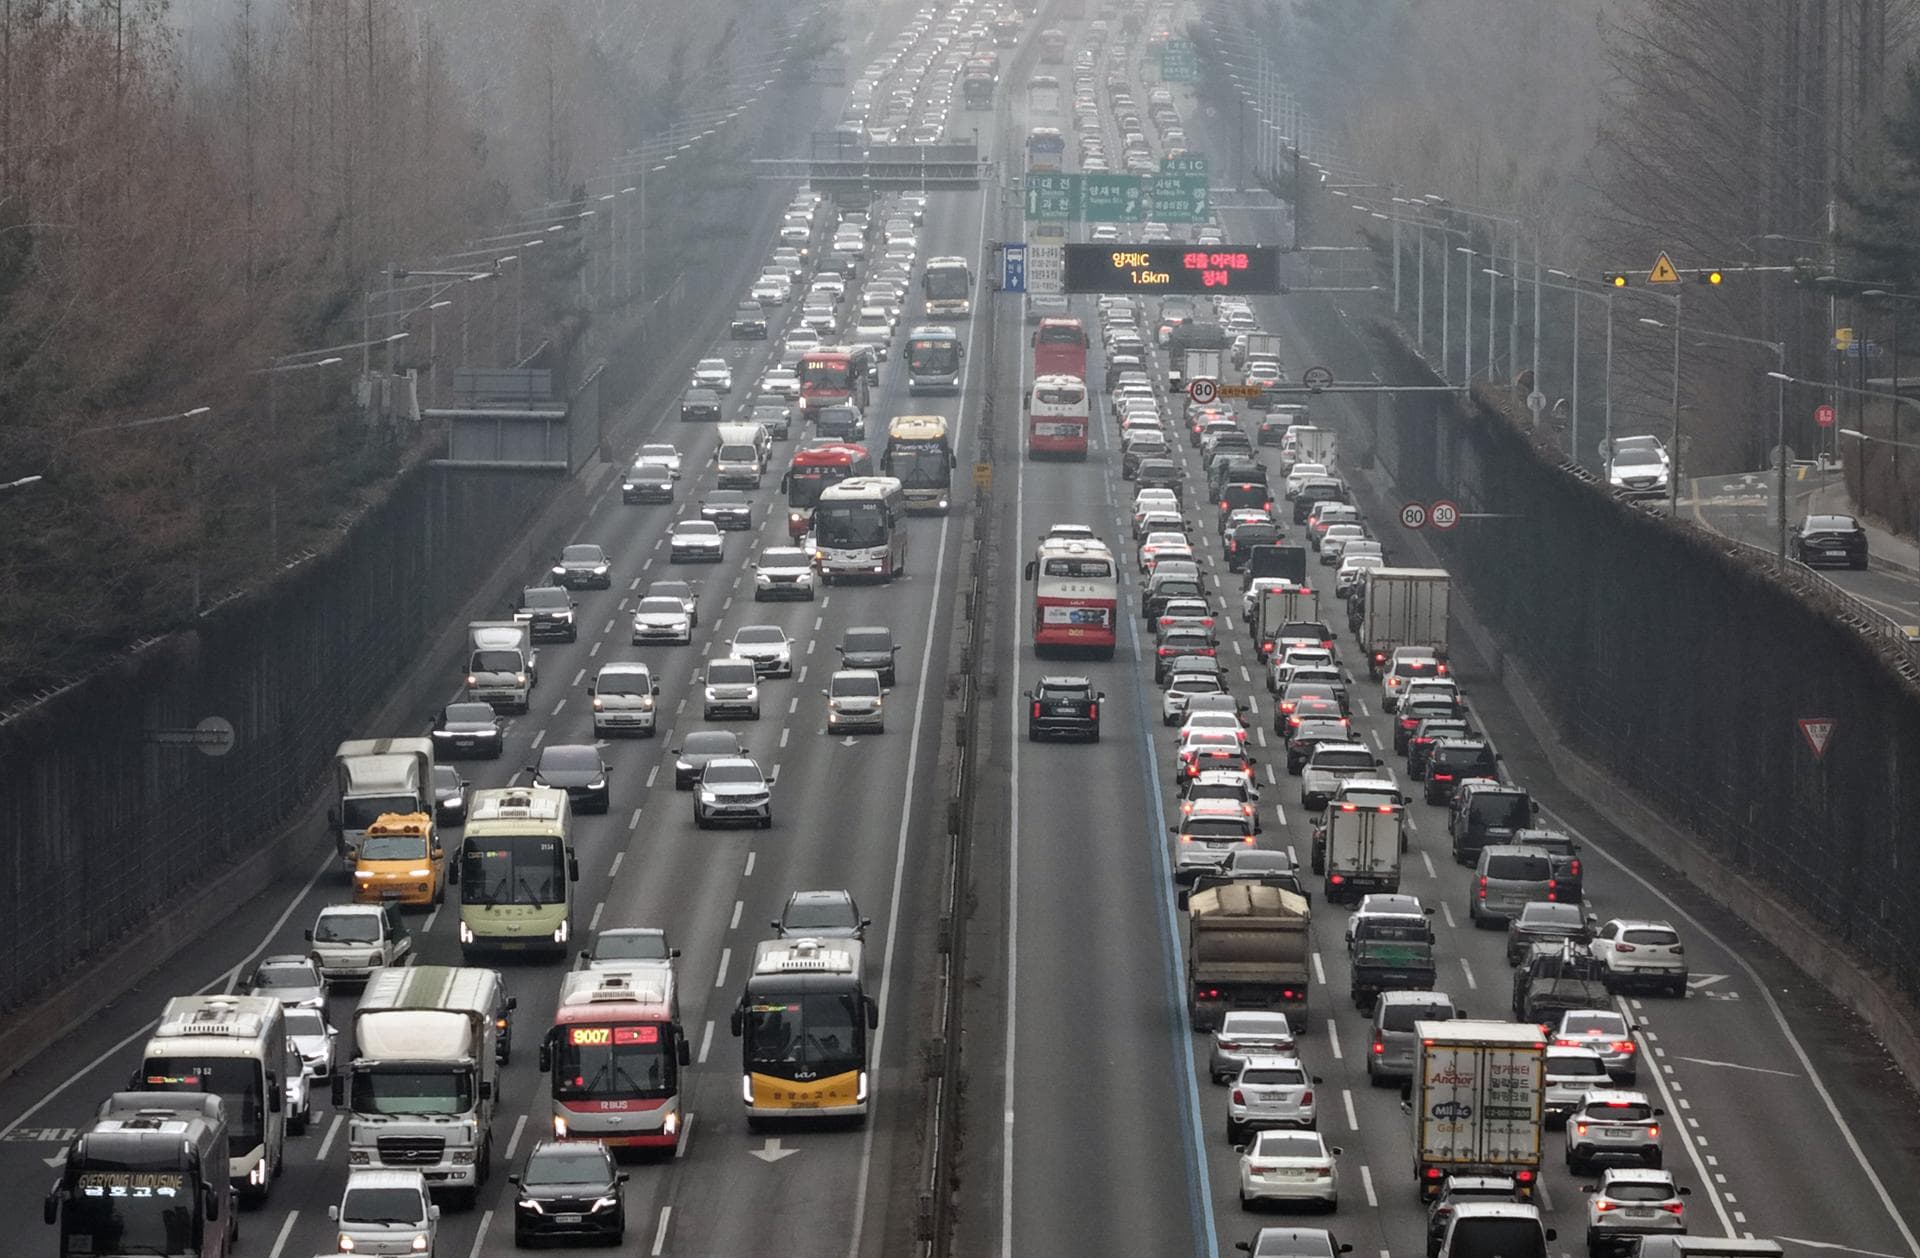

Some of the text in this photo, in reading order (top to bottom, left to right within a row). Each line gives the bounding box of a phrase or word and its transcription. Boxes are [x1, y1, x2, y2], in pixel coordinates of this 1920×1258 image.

[1112, 252, 1149, 268] 양재IC
[1210, 253, 1248, 269] 어려움
[1130, 271, 1170, 284] 1.6km
[1194, 384, 1212, 396] 80
[1405, 509, 1423, 523] 80
[1436, 508, 1453, 520] 30
[573, 1029, 609, 1044] 9007
[1431, 1073, 1473, 1085] Anchor
[609, 1101, 628, 1110] BUS
[1434, 1105, 1470, 1117] Milac
[130, 1173, 183, 1189] LIMOUSINE
